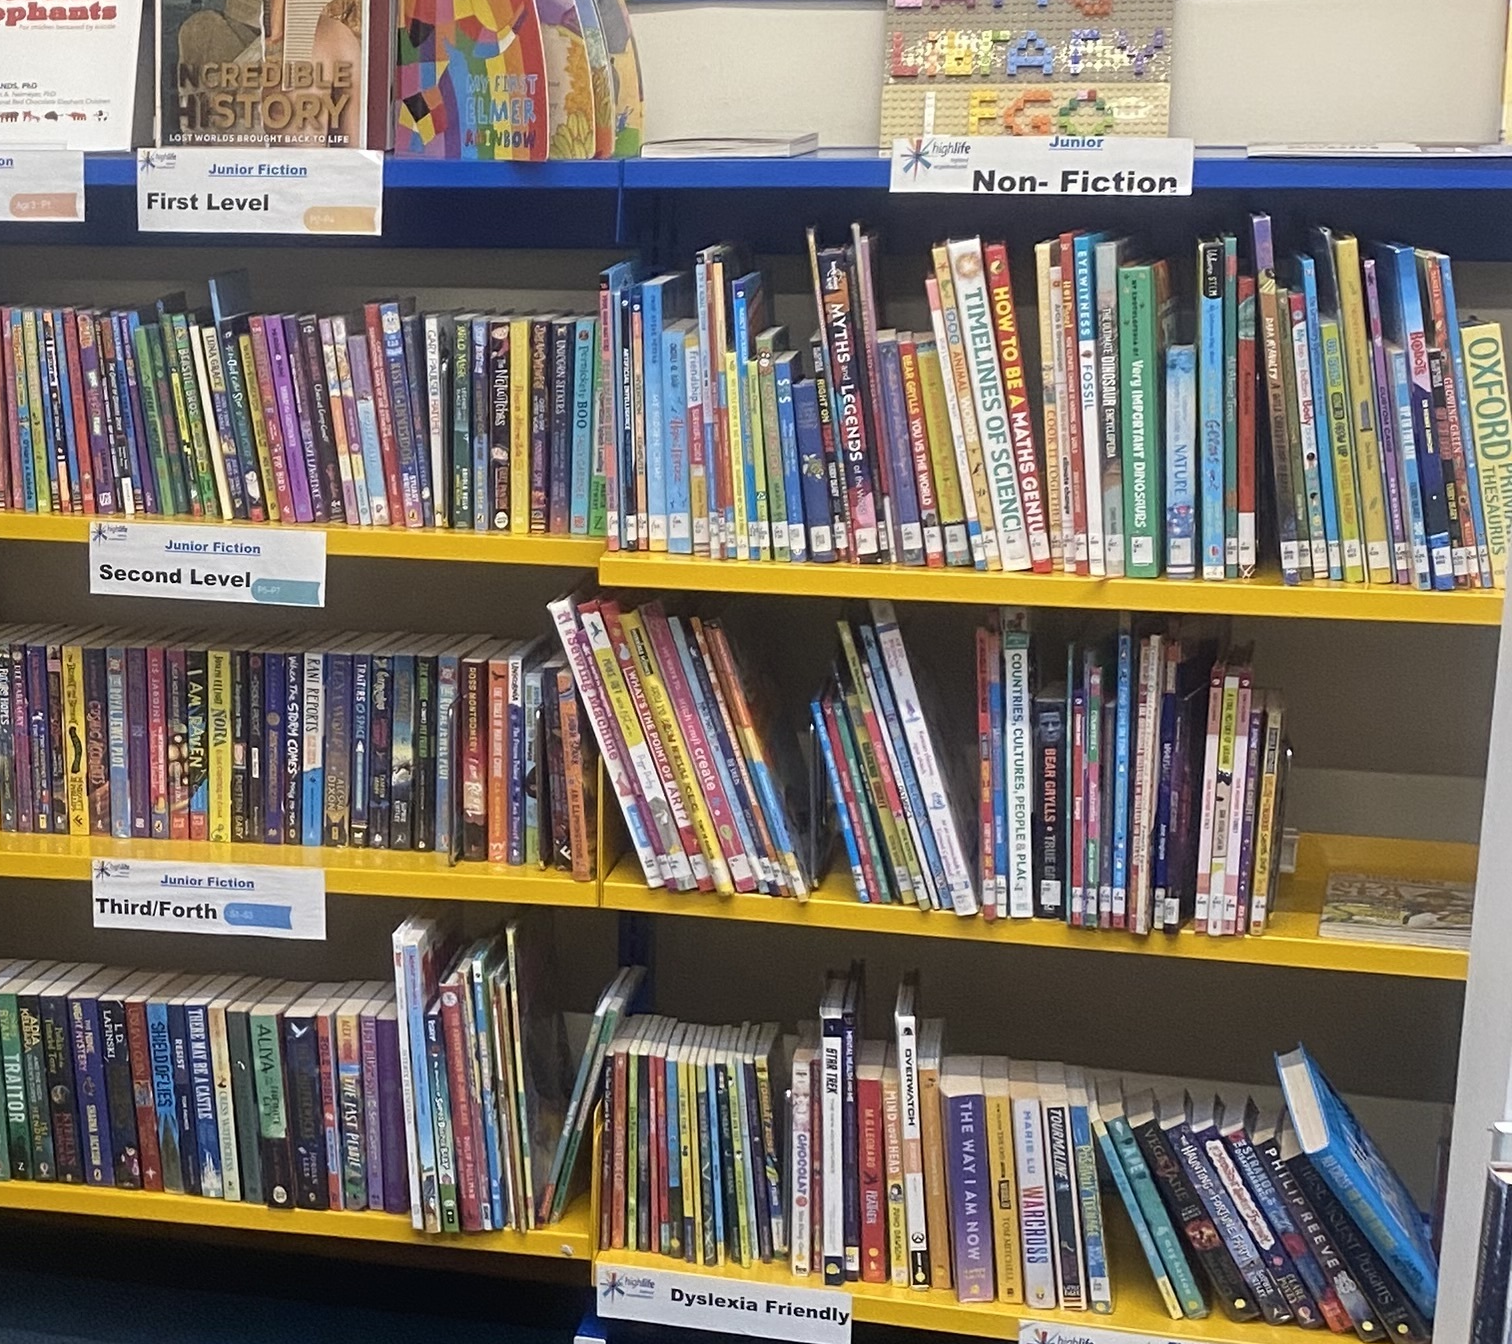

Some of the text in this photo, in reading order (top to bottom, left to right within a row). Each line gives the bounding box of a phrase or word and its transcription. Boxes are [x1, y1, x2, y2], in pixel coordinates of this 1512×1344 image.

[1049, 134, 1104, 151] Junior
[208, 164, 307, 178] Junior Fiction
[972, 170, 1179, 195] Non- Fiction
[146, 193, 269, 212] First Level
[962, 286, 1001, 413] TIMELINES
[1077, 251, 1095, 409] EYEWITNESS FOSSIL
[828, 302, 851, 365] MYTHS
[840, 382, 864, 462] LEGENDS
[1467, 336, 1510, 461] OXFORD
[165, 540, 261, 554] Junior Fiction
[99, 564, 251, 589] Second Level
[161, 875, 255, 890] Junior Fiction
[95, 898, 218, 920] Third/Forth
[4, 1053, 25, 1124] TRAITOR
[826, 1047, 839, 1094] STAR TREK
[905, 1048, 916, 1126] OVERWATCH
[1022, 1185, 1048, 1263] WARCROSS
[670, 1287, 851, 1326] Dyslexia Friendly
